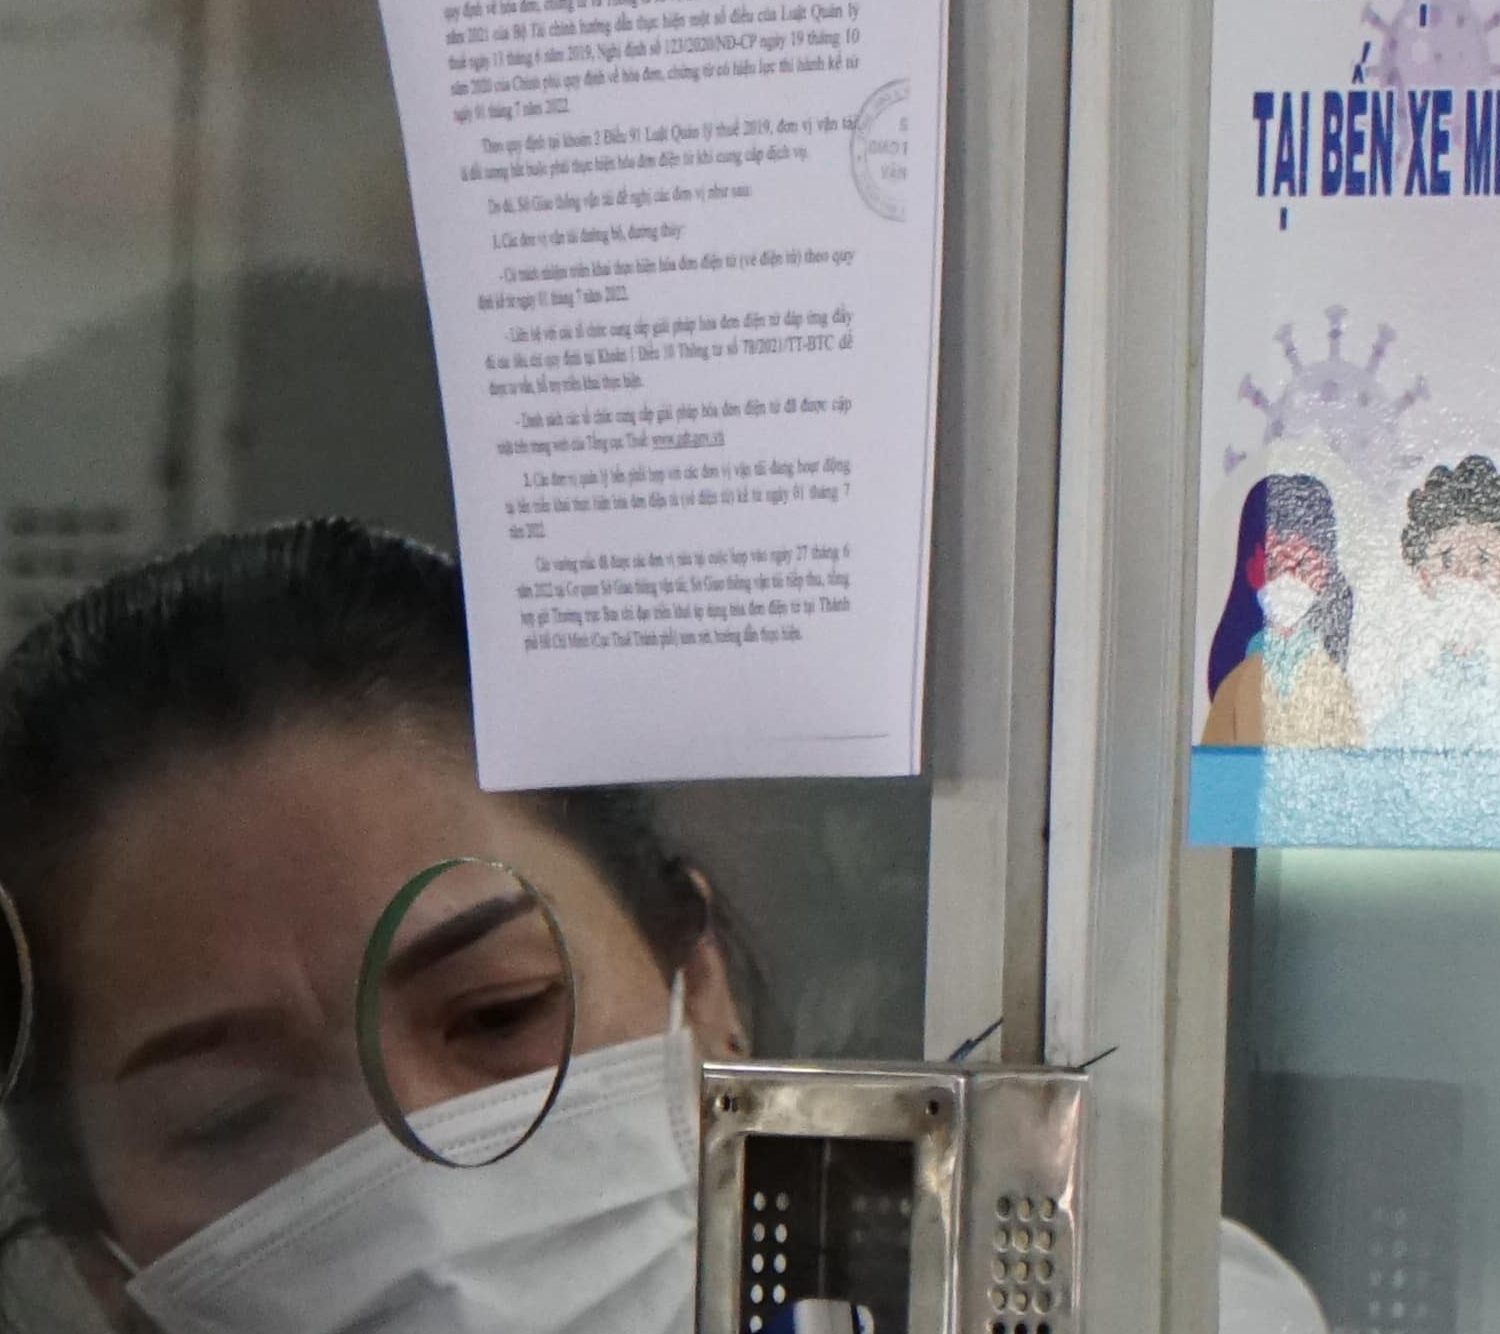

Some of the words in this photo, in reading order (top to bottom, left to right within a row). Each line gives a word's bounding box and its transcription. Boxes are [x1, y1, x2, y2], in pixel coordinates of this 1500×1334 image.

[1252, 90, 1312, 230] TẠI
[1322, 41, 1394, 198] BẾN
[1404, 88, 1453, 198] XE
